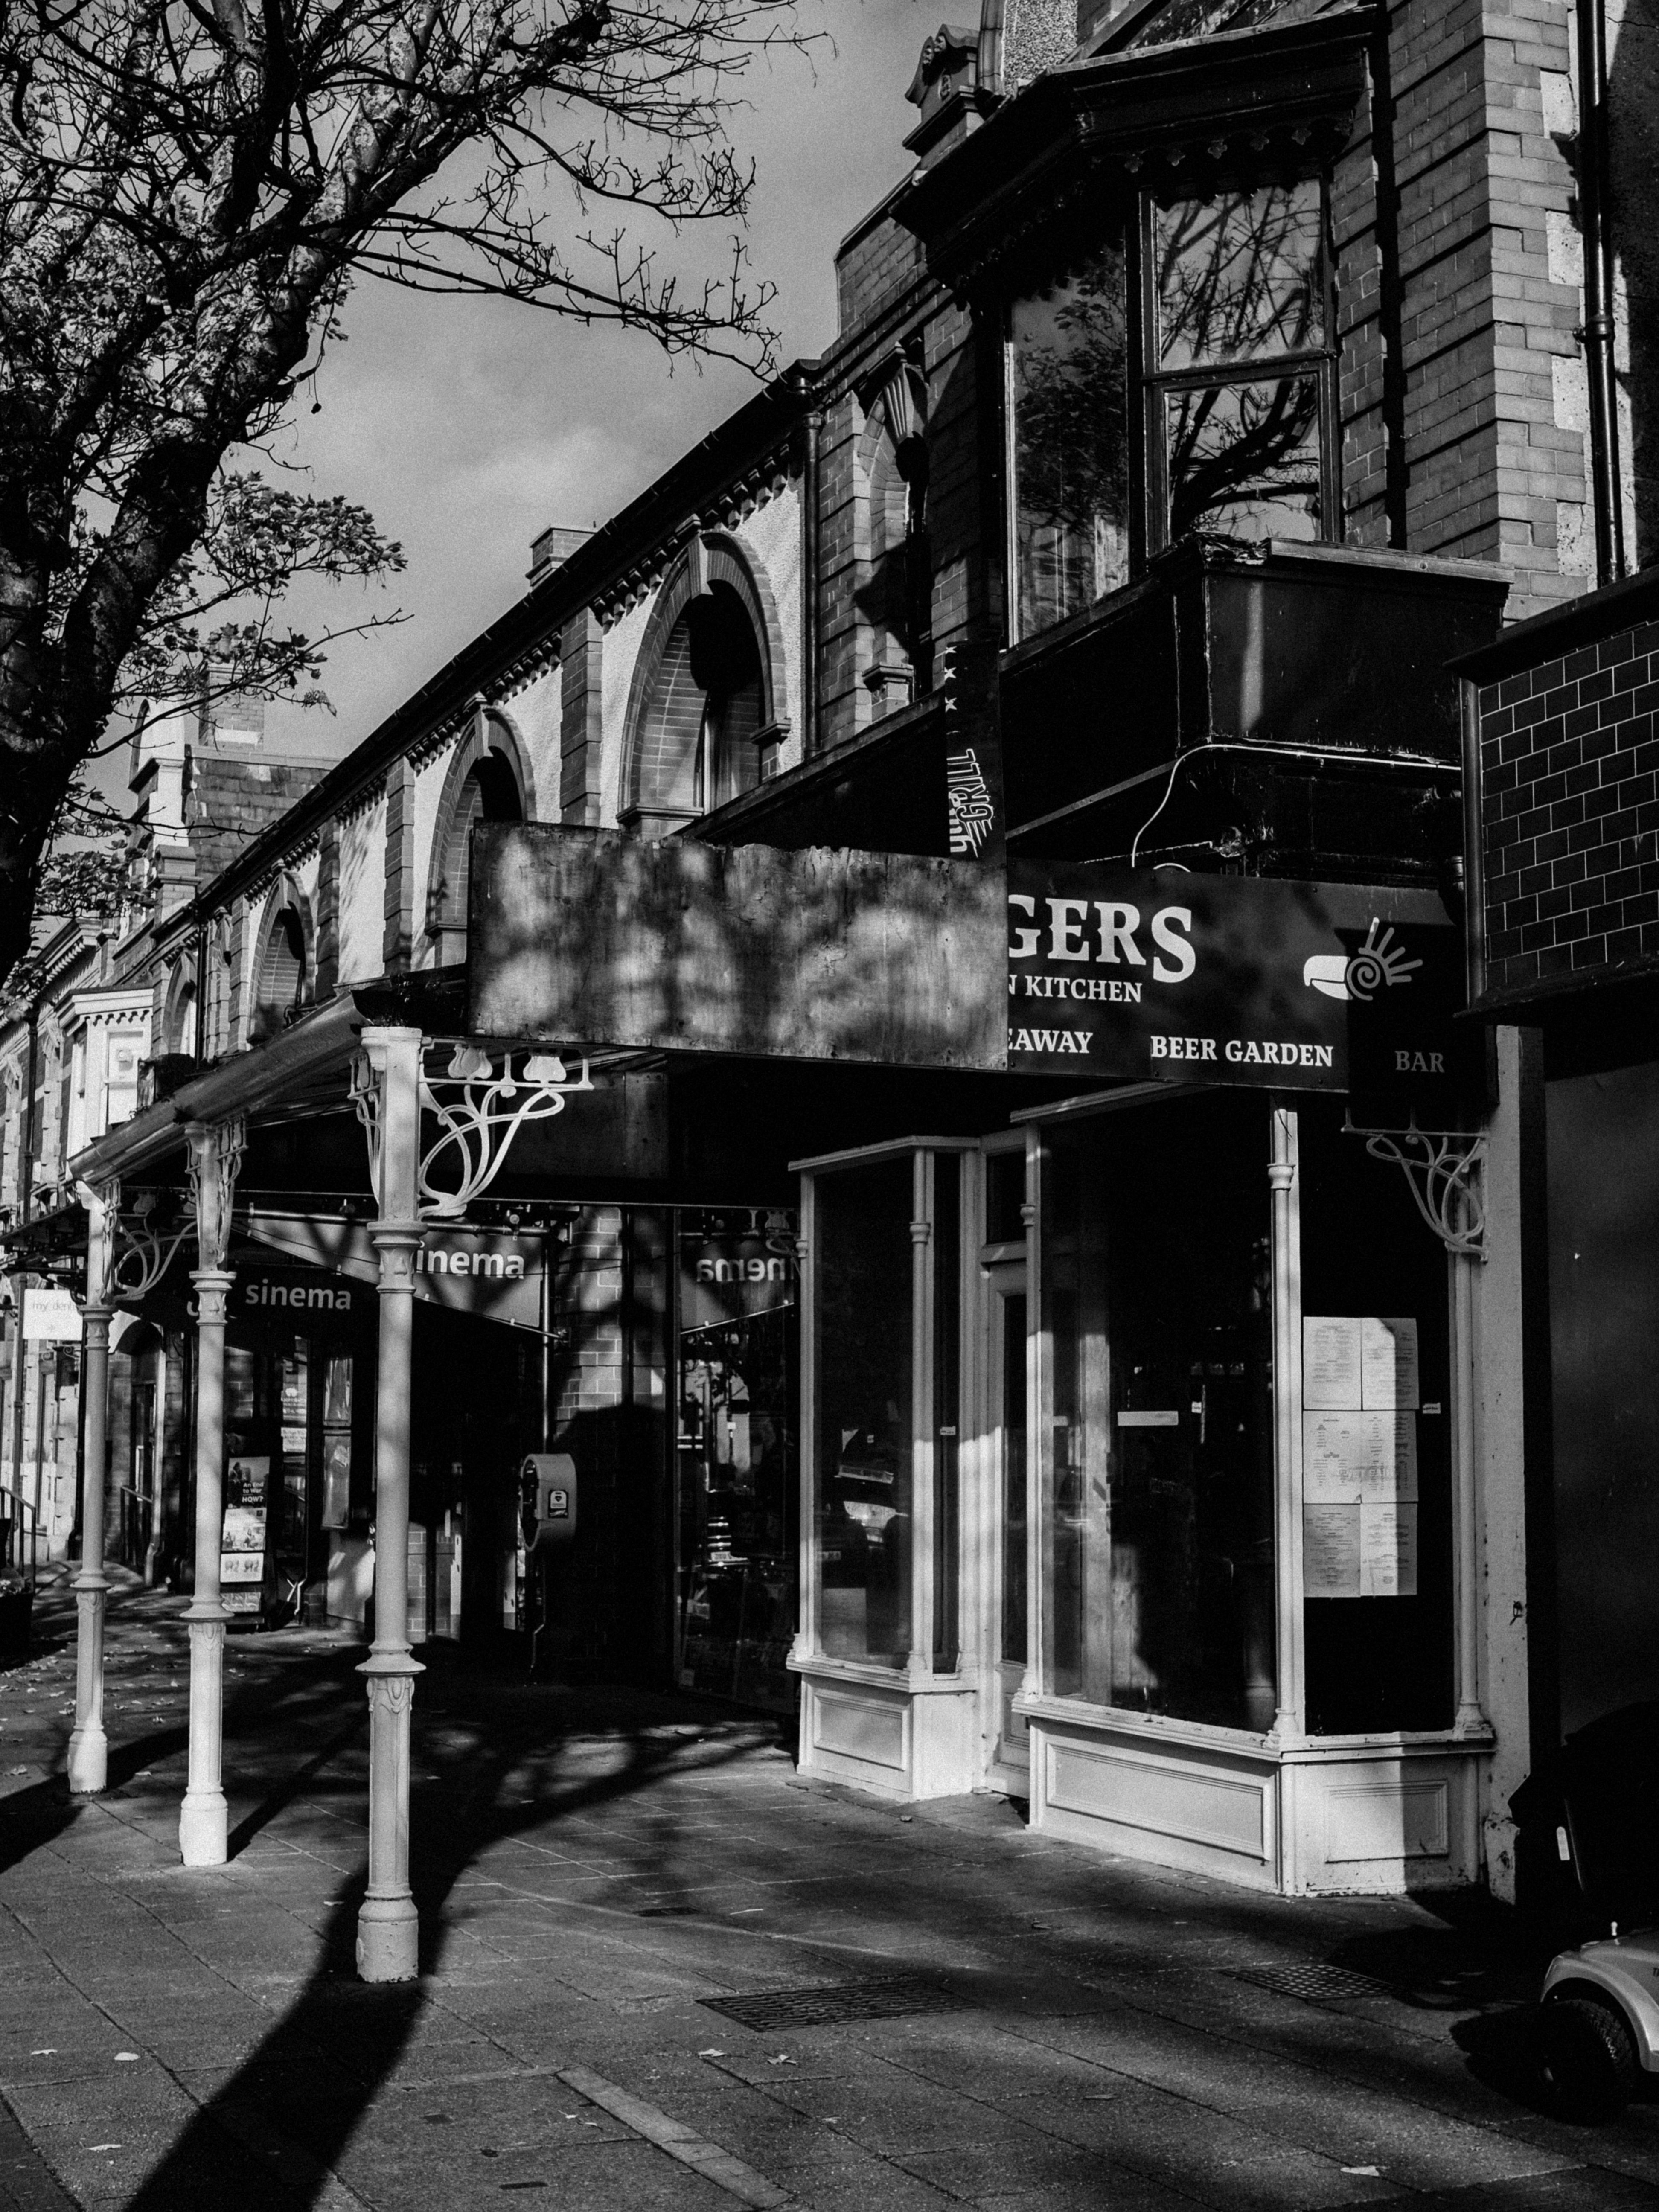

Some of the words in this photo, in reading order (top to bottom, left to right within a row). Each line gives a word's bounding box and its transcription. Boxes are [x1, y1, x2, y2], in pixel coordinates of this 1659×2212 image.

[1025, 975, 1143, 1003] KITCHEN
[1150, 1036, 1218, 1060] BEER
[1225, 1040, 1334, 1067] GARDEN
[1394, 1050, 1445, 1073] BAR
[416, 1240, 525, 1279] inema
[245, 1278, 351, 1310] sinema
